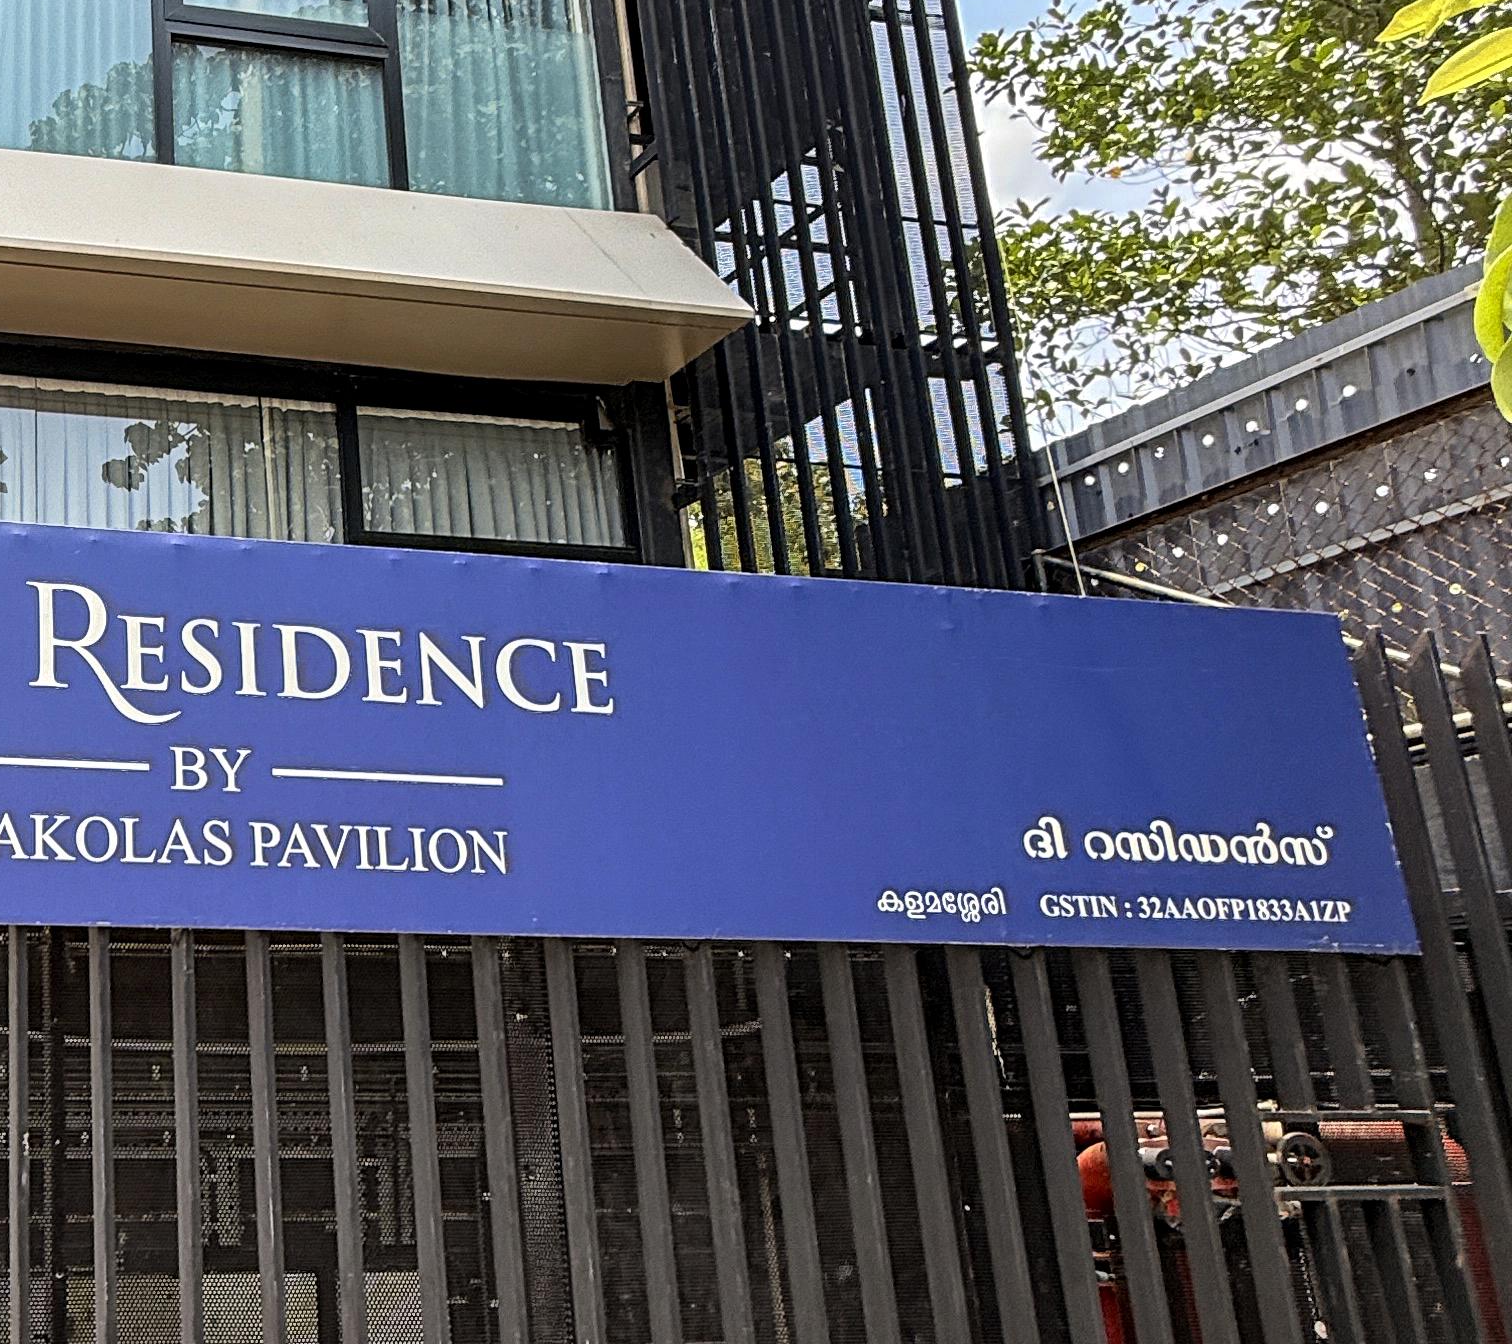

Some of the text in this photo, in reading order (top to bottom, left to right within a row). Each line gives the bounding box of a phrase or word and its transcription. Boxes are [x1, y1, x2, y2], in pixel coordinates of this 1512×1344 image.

[25, 578, 616, 725] RESIDENCE
[169, 746, 252, 793] BY
[248, 821, 508, 875] PAVILION
[1023, 816, 1068, 859] ദി
[877, 887, 1007, 923] കളമശ്ശേരി
[1039, 894, 1118, 918] GSTIN
[1137, 896, 1351, 923] 32AAOFP1833A1ZP
